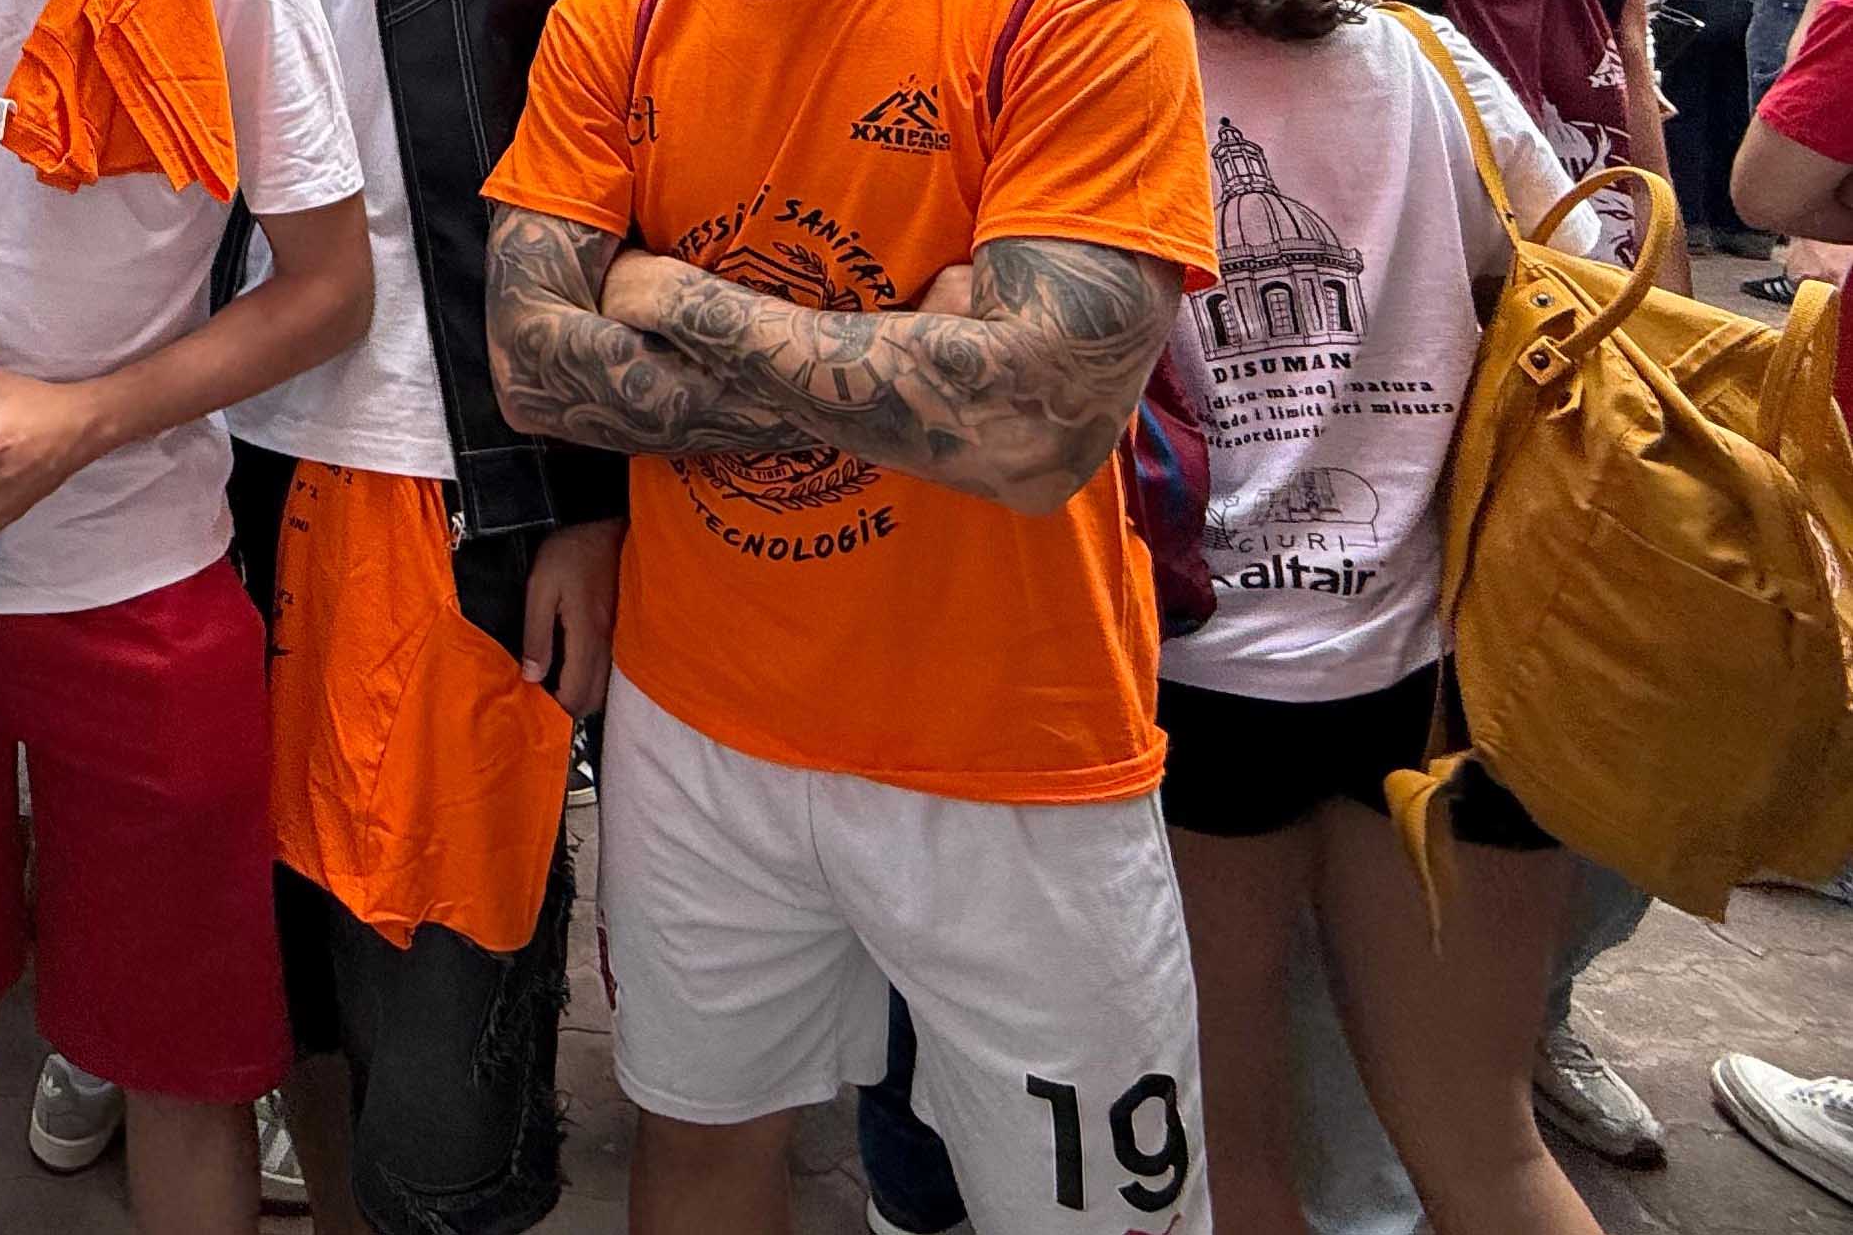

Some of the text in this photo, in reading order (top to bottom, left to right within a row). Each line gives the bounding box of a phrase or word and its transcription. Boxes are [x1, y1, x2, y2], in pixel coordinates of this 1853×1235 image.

[850, 122, 904, 145] XXI
[1212, 352, 1353, 384] DISUMAN
[1238, 532, 1345, 554] CIURI
[1240, 554, 1376, 596] altair
[1026, 1071, 1190, 1213] 19
